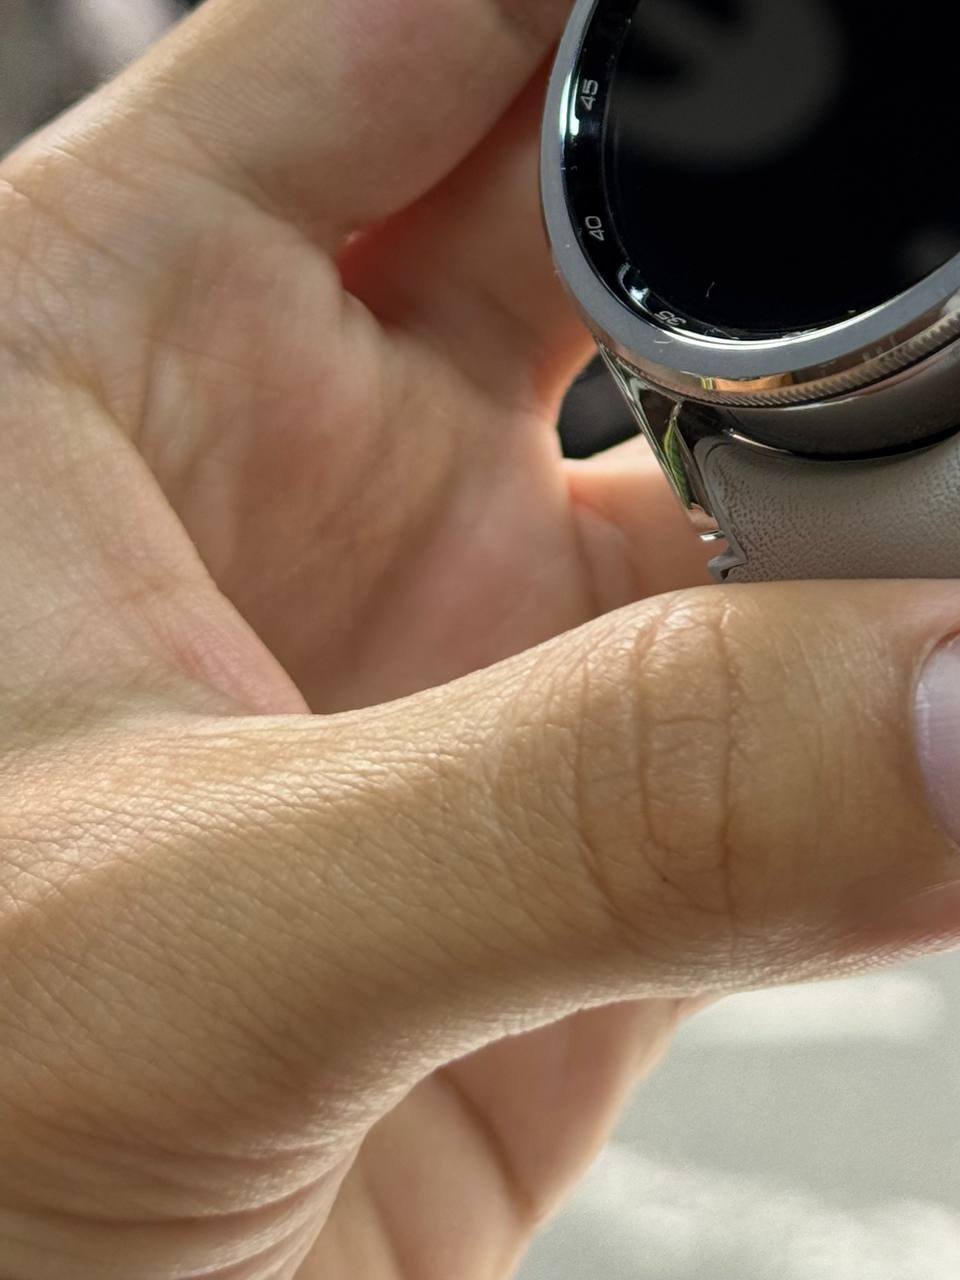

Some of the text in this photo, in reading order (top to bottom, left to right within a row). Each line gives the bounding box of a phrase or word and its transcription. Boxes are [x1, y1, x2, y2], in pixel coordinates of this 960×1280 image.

[581, 79, 599, 111] 45
[585, 216, 605, 241] 40
[654, 310, 687, 326] 35
